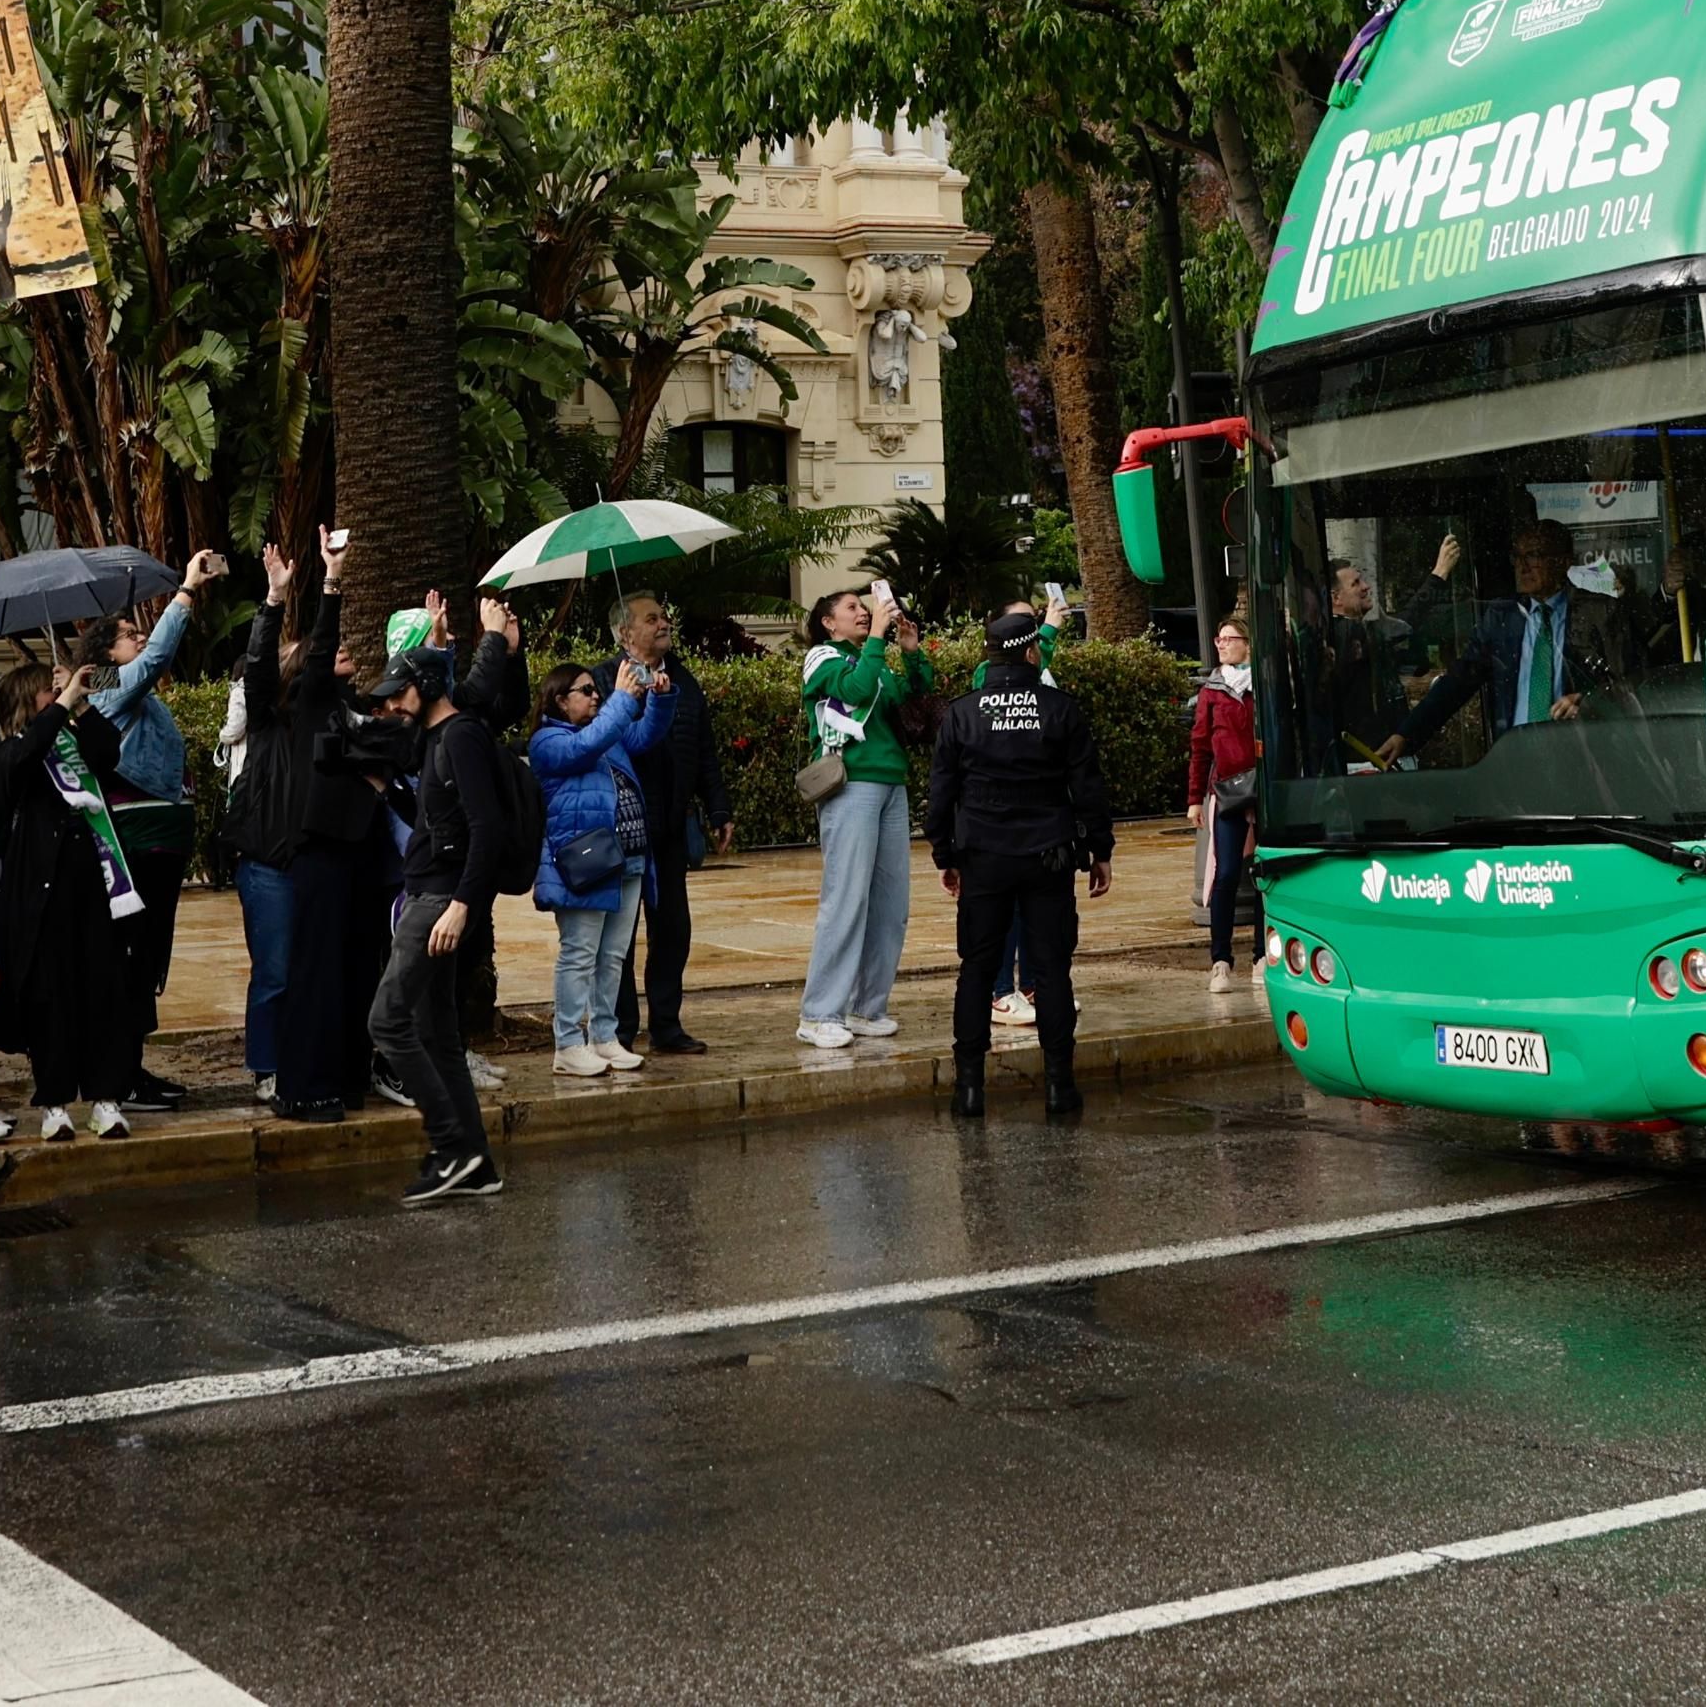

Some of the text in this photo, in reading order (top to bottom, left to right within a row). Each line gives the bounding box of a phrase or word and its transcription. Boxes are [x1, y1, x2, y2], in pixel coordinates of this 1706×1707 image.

[1518, 1, 1562, 24] FINAL
[1294, 76, 1681, 316] CAMPEONES
[1487, 192, 1654, 262] BELGRADO 2024
[1329, 217, 1485, 304] FINAL FOUR
[979, 690, 1038, 707] POLICÍA
[991, 718, 1041, 731] MÁLAGA
[1006, 707, 1039, 717] LOCAL
[1495, 861, 1573, 883] Fundación
[1390, 873, 1451, 905] Unicaja
[1496, 883, 1554, 909] Unicaja
[1454, 1032, 1539, 1068] 8400 GXK
